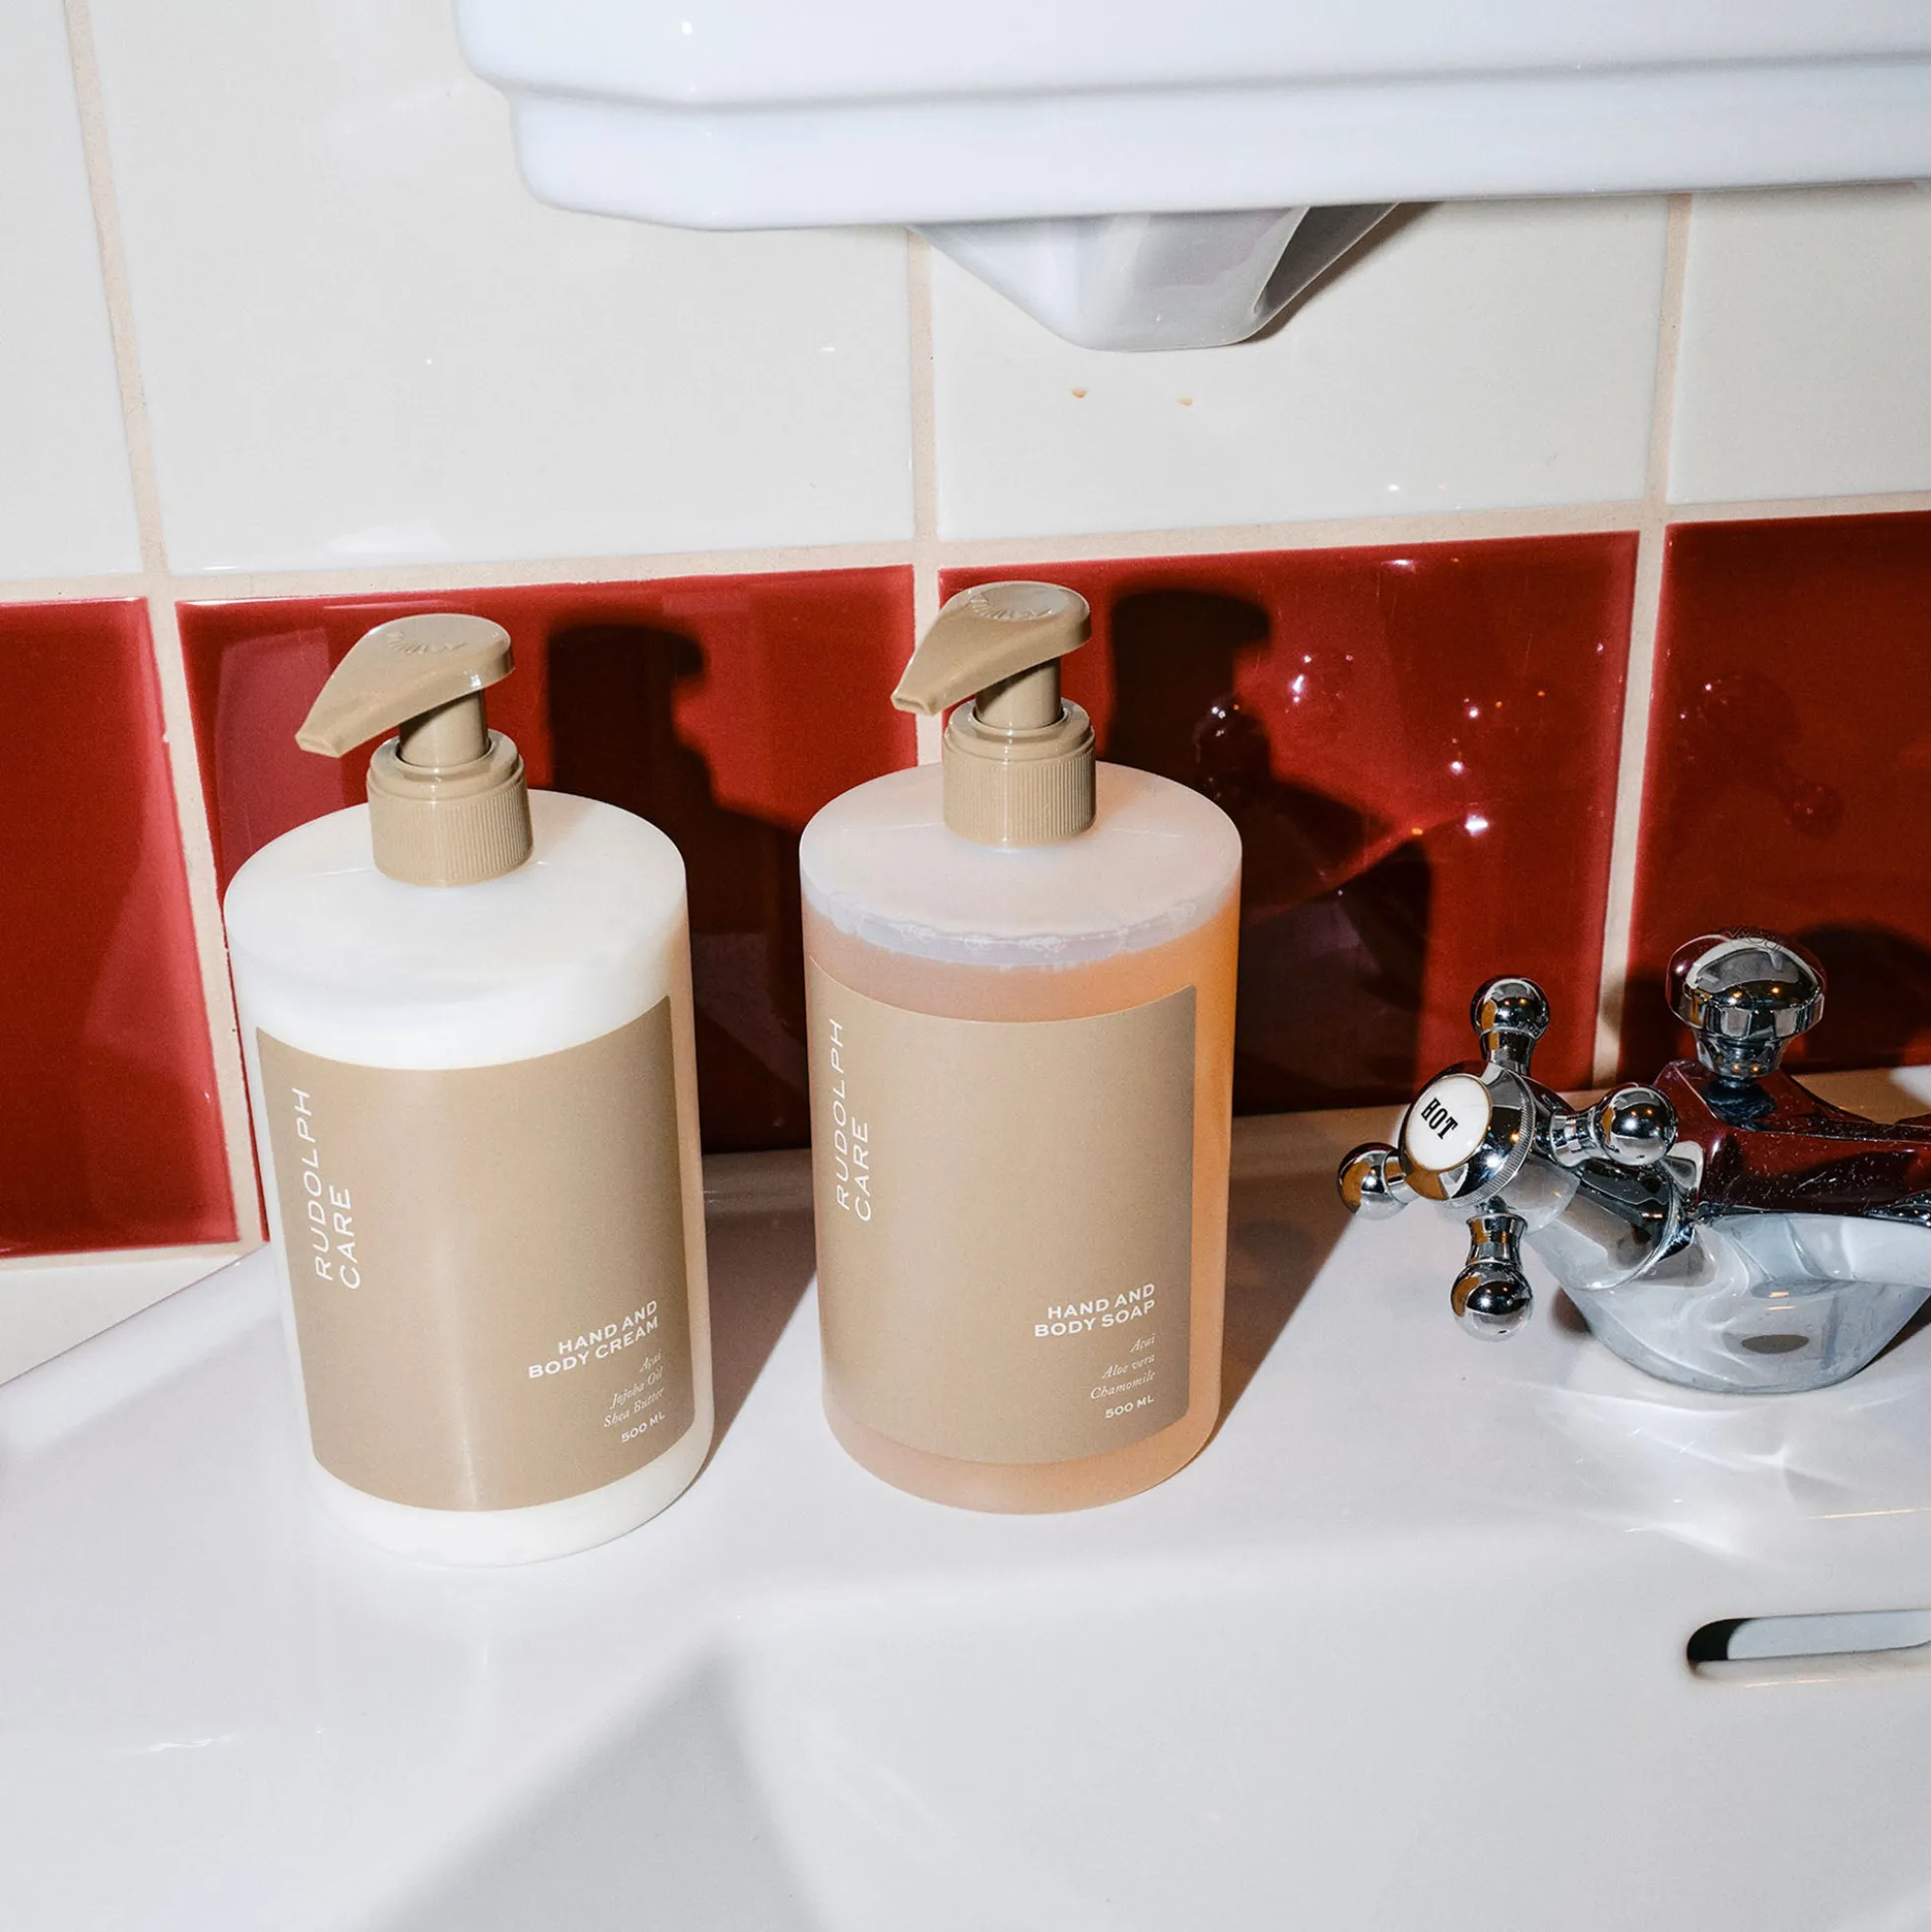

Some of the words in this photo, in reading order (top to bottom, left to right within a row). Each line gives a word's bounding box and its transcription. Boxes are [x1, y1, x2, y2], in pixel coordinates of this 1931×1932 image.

[829, 1018, 850, 1211] RUDOLPH
[1420, 1097, 1459, 1140] HOT
[291, 1088, 333, 1281] RUDOLPH
[851, 1116, 872, 1222] CARE
[329, 1185, 361, 1290] CARE
[1034, 1317, 1097, 1337] BODY
[1101, 1299, 1156, 1327] SOAP
[1047, 1299, 1109, 1320] HAND
[1114, 1283, 1156, 1308] AND
[528, 1351, 590, 1379] BODY
[595, 1316, 658, 1360] CREAM
[558, 1323, 618, 1356] HAND
[622, 1300, 657, 1332] AND
[609, 1381, 645, 1411] Jojoba
[647, 1366, 665, 1386] Oil
[1091, 1369, 1157, 1400] Chamomile
[1101, 1364, 1129, 1380] Aloe
[1131, 1354, 1156, 1370] vera
[603, 1408, 631, 1428] Shea
[633, 1387, 665, 1415] Butter
[621, 1422, 648, 1443] 500
[649, 1411, 666, 1428] ML
[1104, 1402, 1134, 1420] 500
[1137, 1393, 1156, 1409] ML
